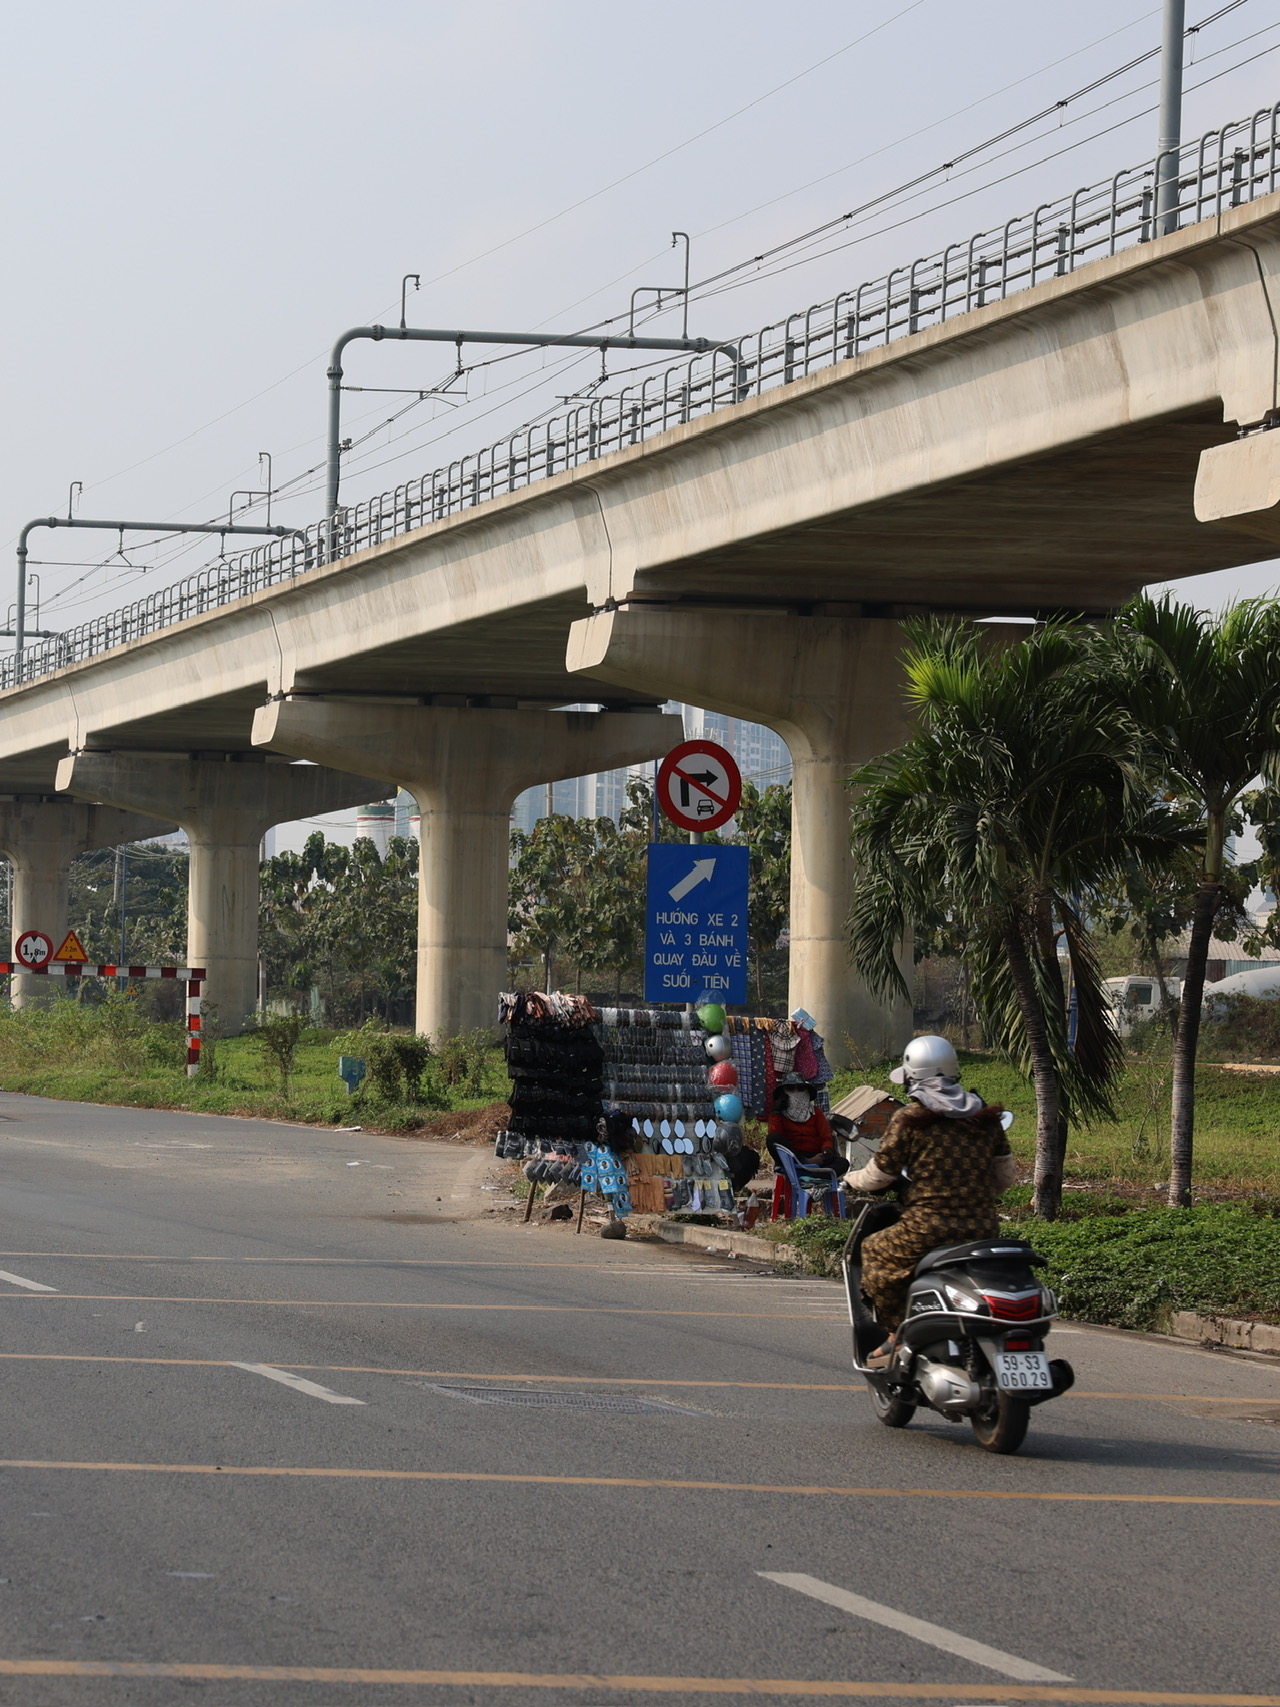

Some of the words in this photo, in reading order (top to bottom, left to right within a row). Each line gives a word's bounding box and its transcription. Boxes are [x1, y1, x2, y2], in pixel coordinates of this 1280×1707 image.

[656, 907, 699, 925] HƯỚNG
[707, 913, 724, 926] XE
[731, 914, 738, 927] 2
[660, 930, 676, 945] VÀ
[684, 933, 692, 946] 3
[699, 931, 734, 947] BÁNH
[653, 953, 684, 966] QUAY
[692, 948, 717, 966] ĐẦU
[725, 948, 741, 967] VỀ
[663, 968, 690, 988] SUỐI
[702, 973, 729, 989] TIÊN
[1002, 1355, 1040, 1370] 59-S3
[1001, 1371, 1048, 1387] 060.29
